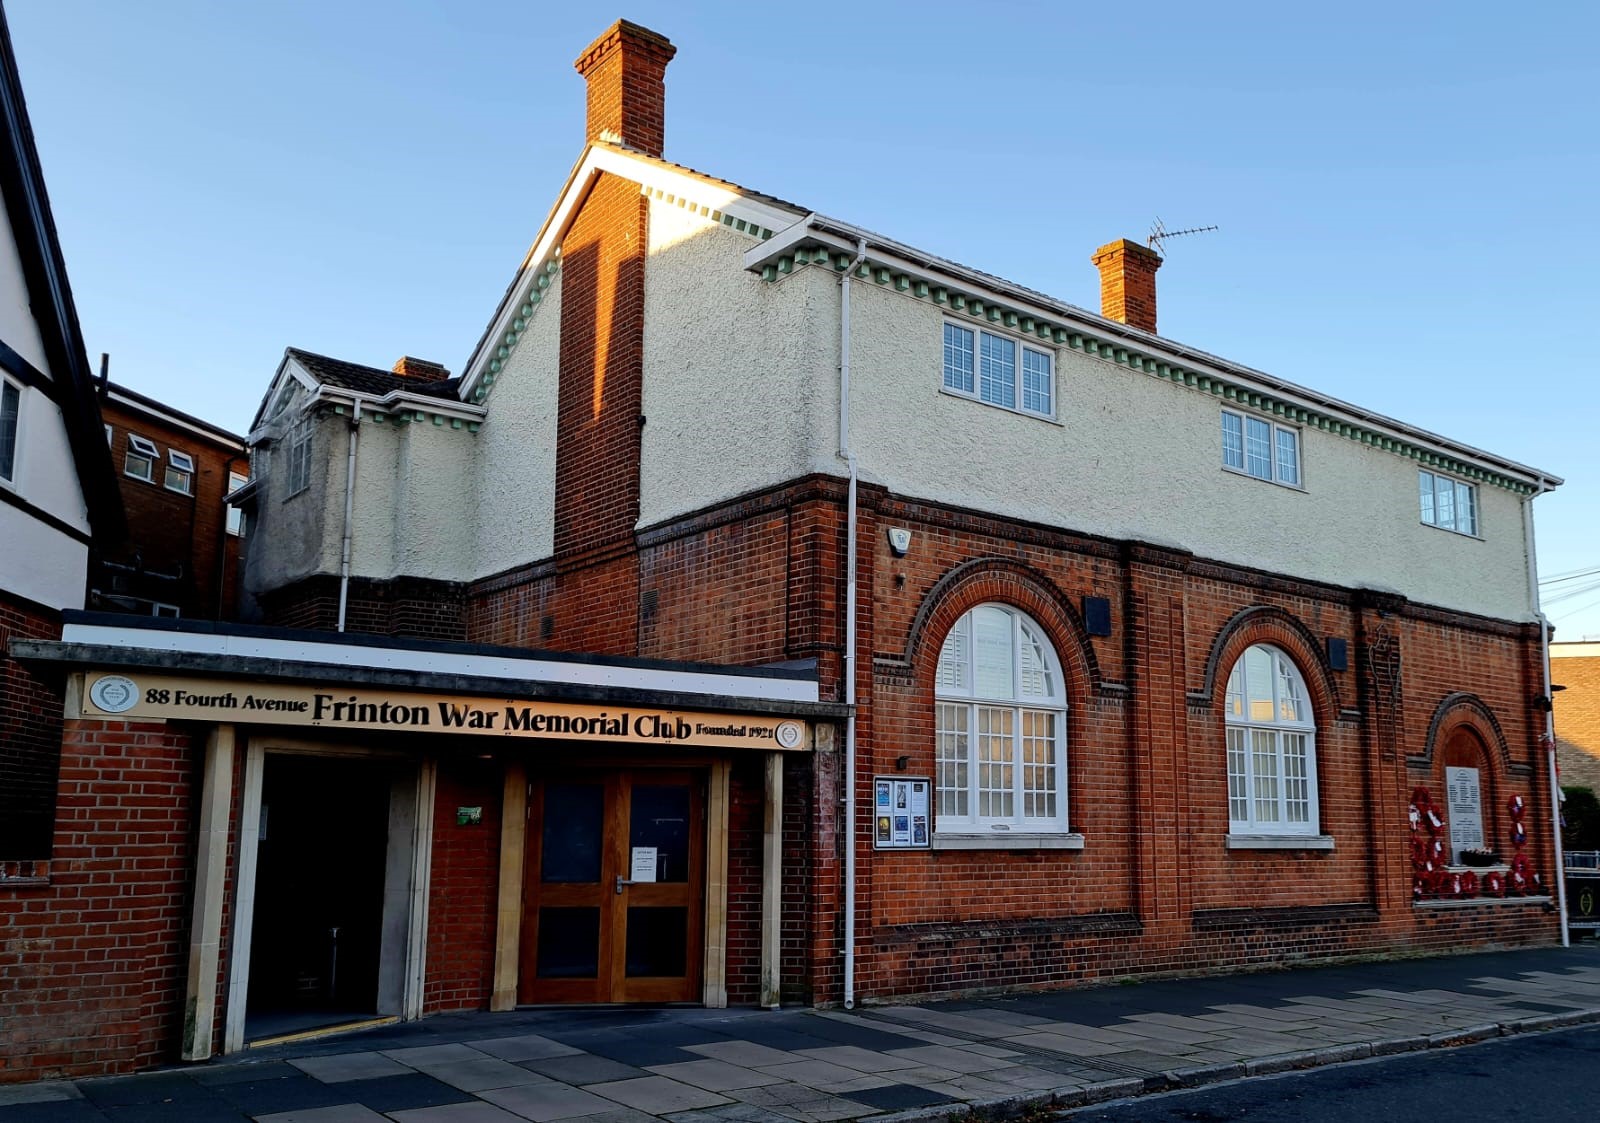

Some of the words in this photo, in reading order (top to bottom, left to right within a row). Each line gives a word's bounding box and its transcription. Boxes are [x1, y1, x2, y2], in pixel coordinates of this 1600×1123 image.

[145, 689, 170, 704] 88
[174, 690, 237, 708] Fourth
[242, 695, 308, 712] Avenue
[312, 694, 430, 725] Frinton
[438, 702, 499, 729] War
[503, 706, 629, 736] Memorial
[634, 715, 692, 739] Club
[696, 723, 746, 736] Founded
